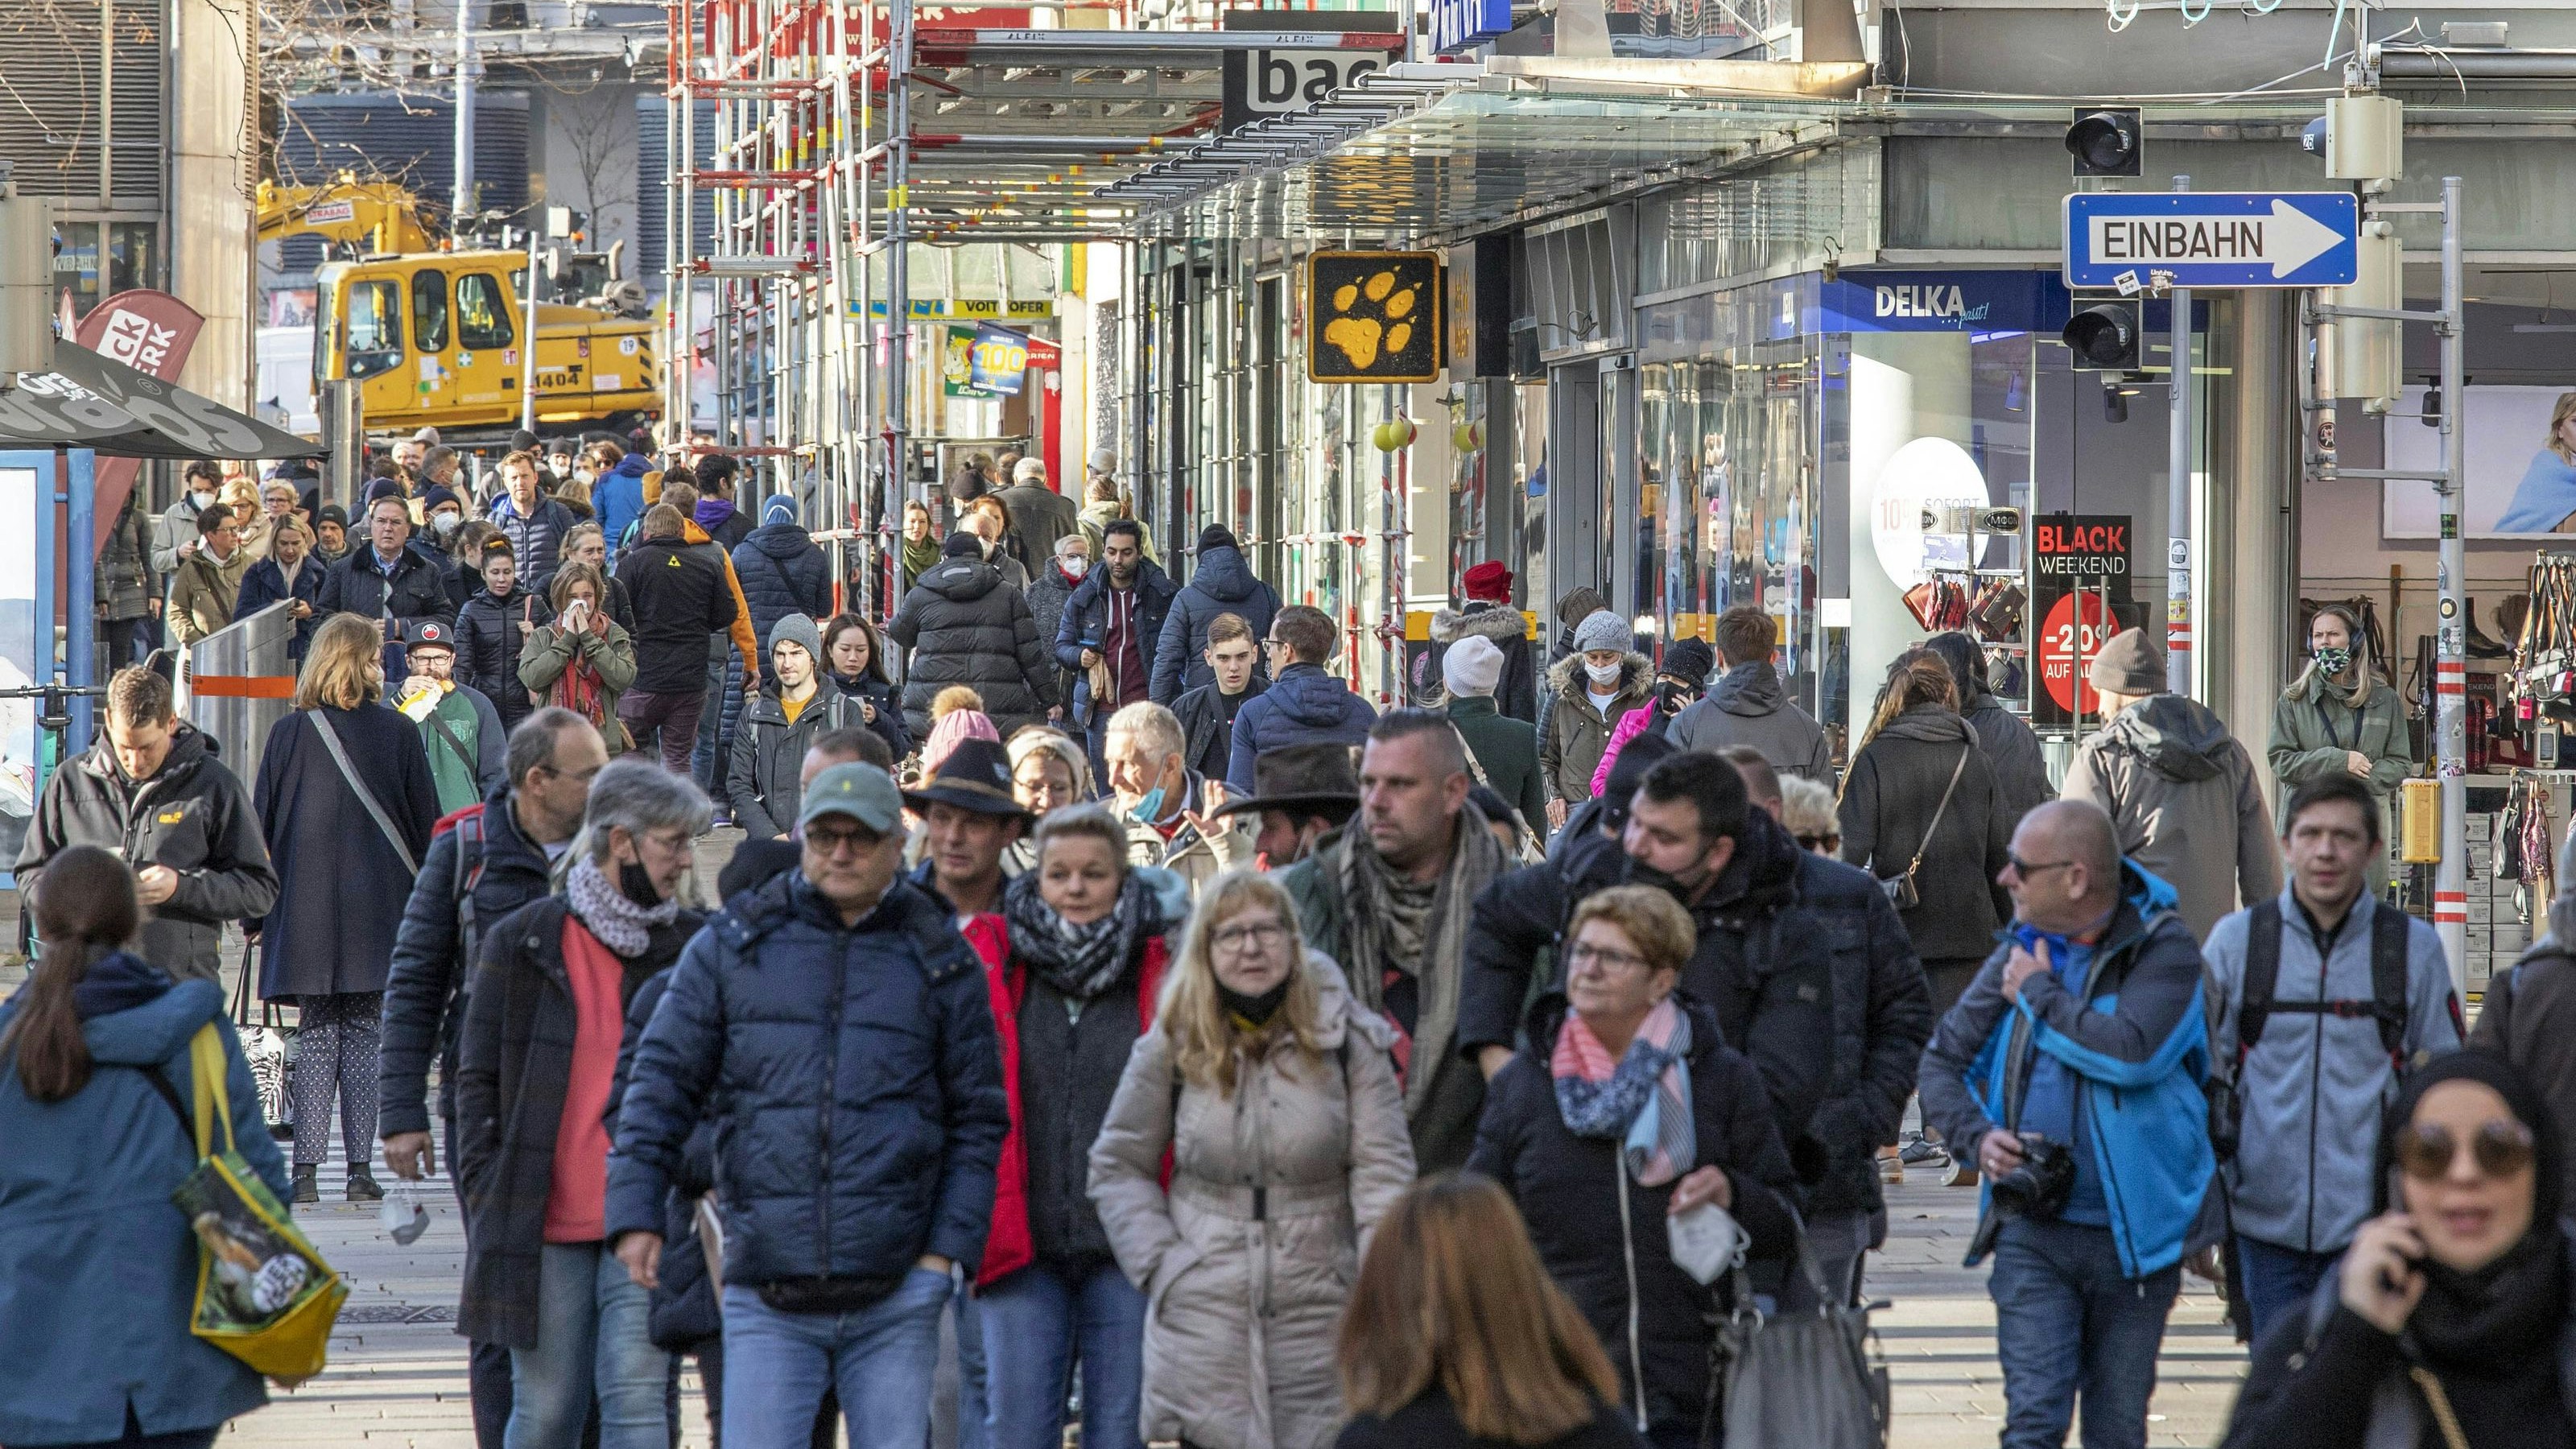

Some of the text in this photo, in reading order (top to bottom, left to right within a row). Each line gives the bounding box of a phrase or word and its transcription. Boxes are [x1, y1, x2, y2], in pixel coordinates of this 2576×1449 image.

[846, 34, 879, 46] Win
[1276, 35, 1314, 43] ALFIX
[2303, 135, 2314, 149] 26
[2104, 221, 2263, 258] EINBAHN
[966, 301, 1044, 312] VOITOFER
[1876, 286, 1965, 317] DELKA
[623, 340, 634, 351] 19
[976, 342, 1027, 372] 100
[535, 373, 578, 388] 1404
[2038, 526, 2125, 552] BLACK
[2038, 556, 2126, 574] WEEKEND
[2046, 663, 2070, 679] AUF
